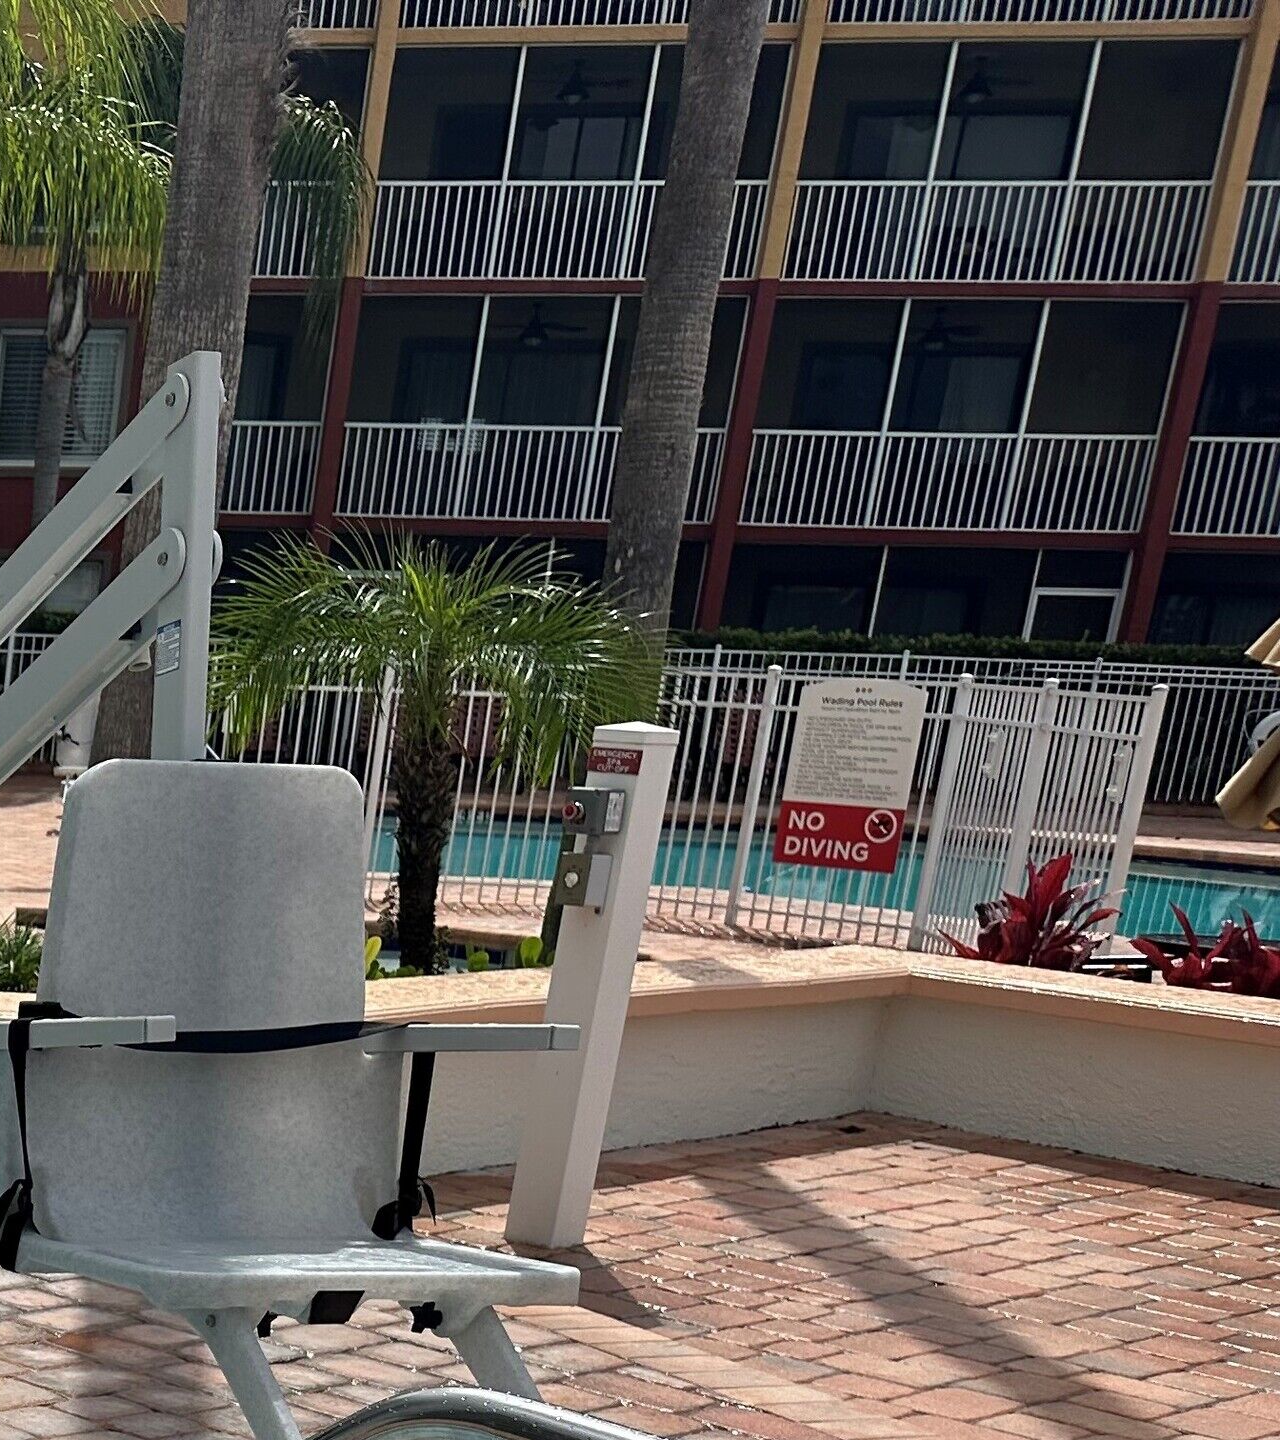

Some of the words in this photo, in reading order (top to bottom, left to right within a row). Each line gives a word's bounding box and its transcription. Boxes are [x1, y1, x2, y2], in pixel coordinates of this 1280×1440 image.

[822, 696, 855, 706] Wading
[857, 697, 877, 706] Pool
[879, 698, 904, 708] Rules
[593, 750, 638, 759] EMERGENCY
[788, 810, 825, 831] NO
[784, 835, 868, 862] DIVING
